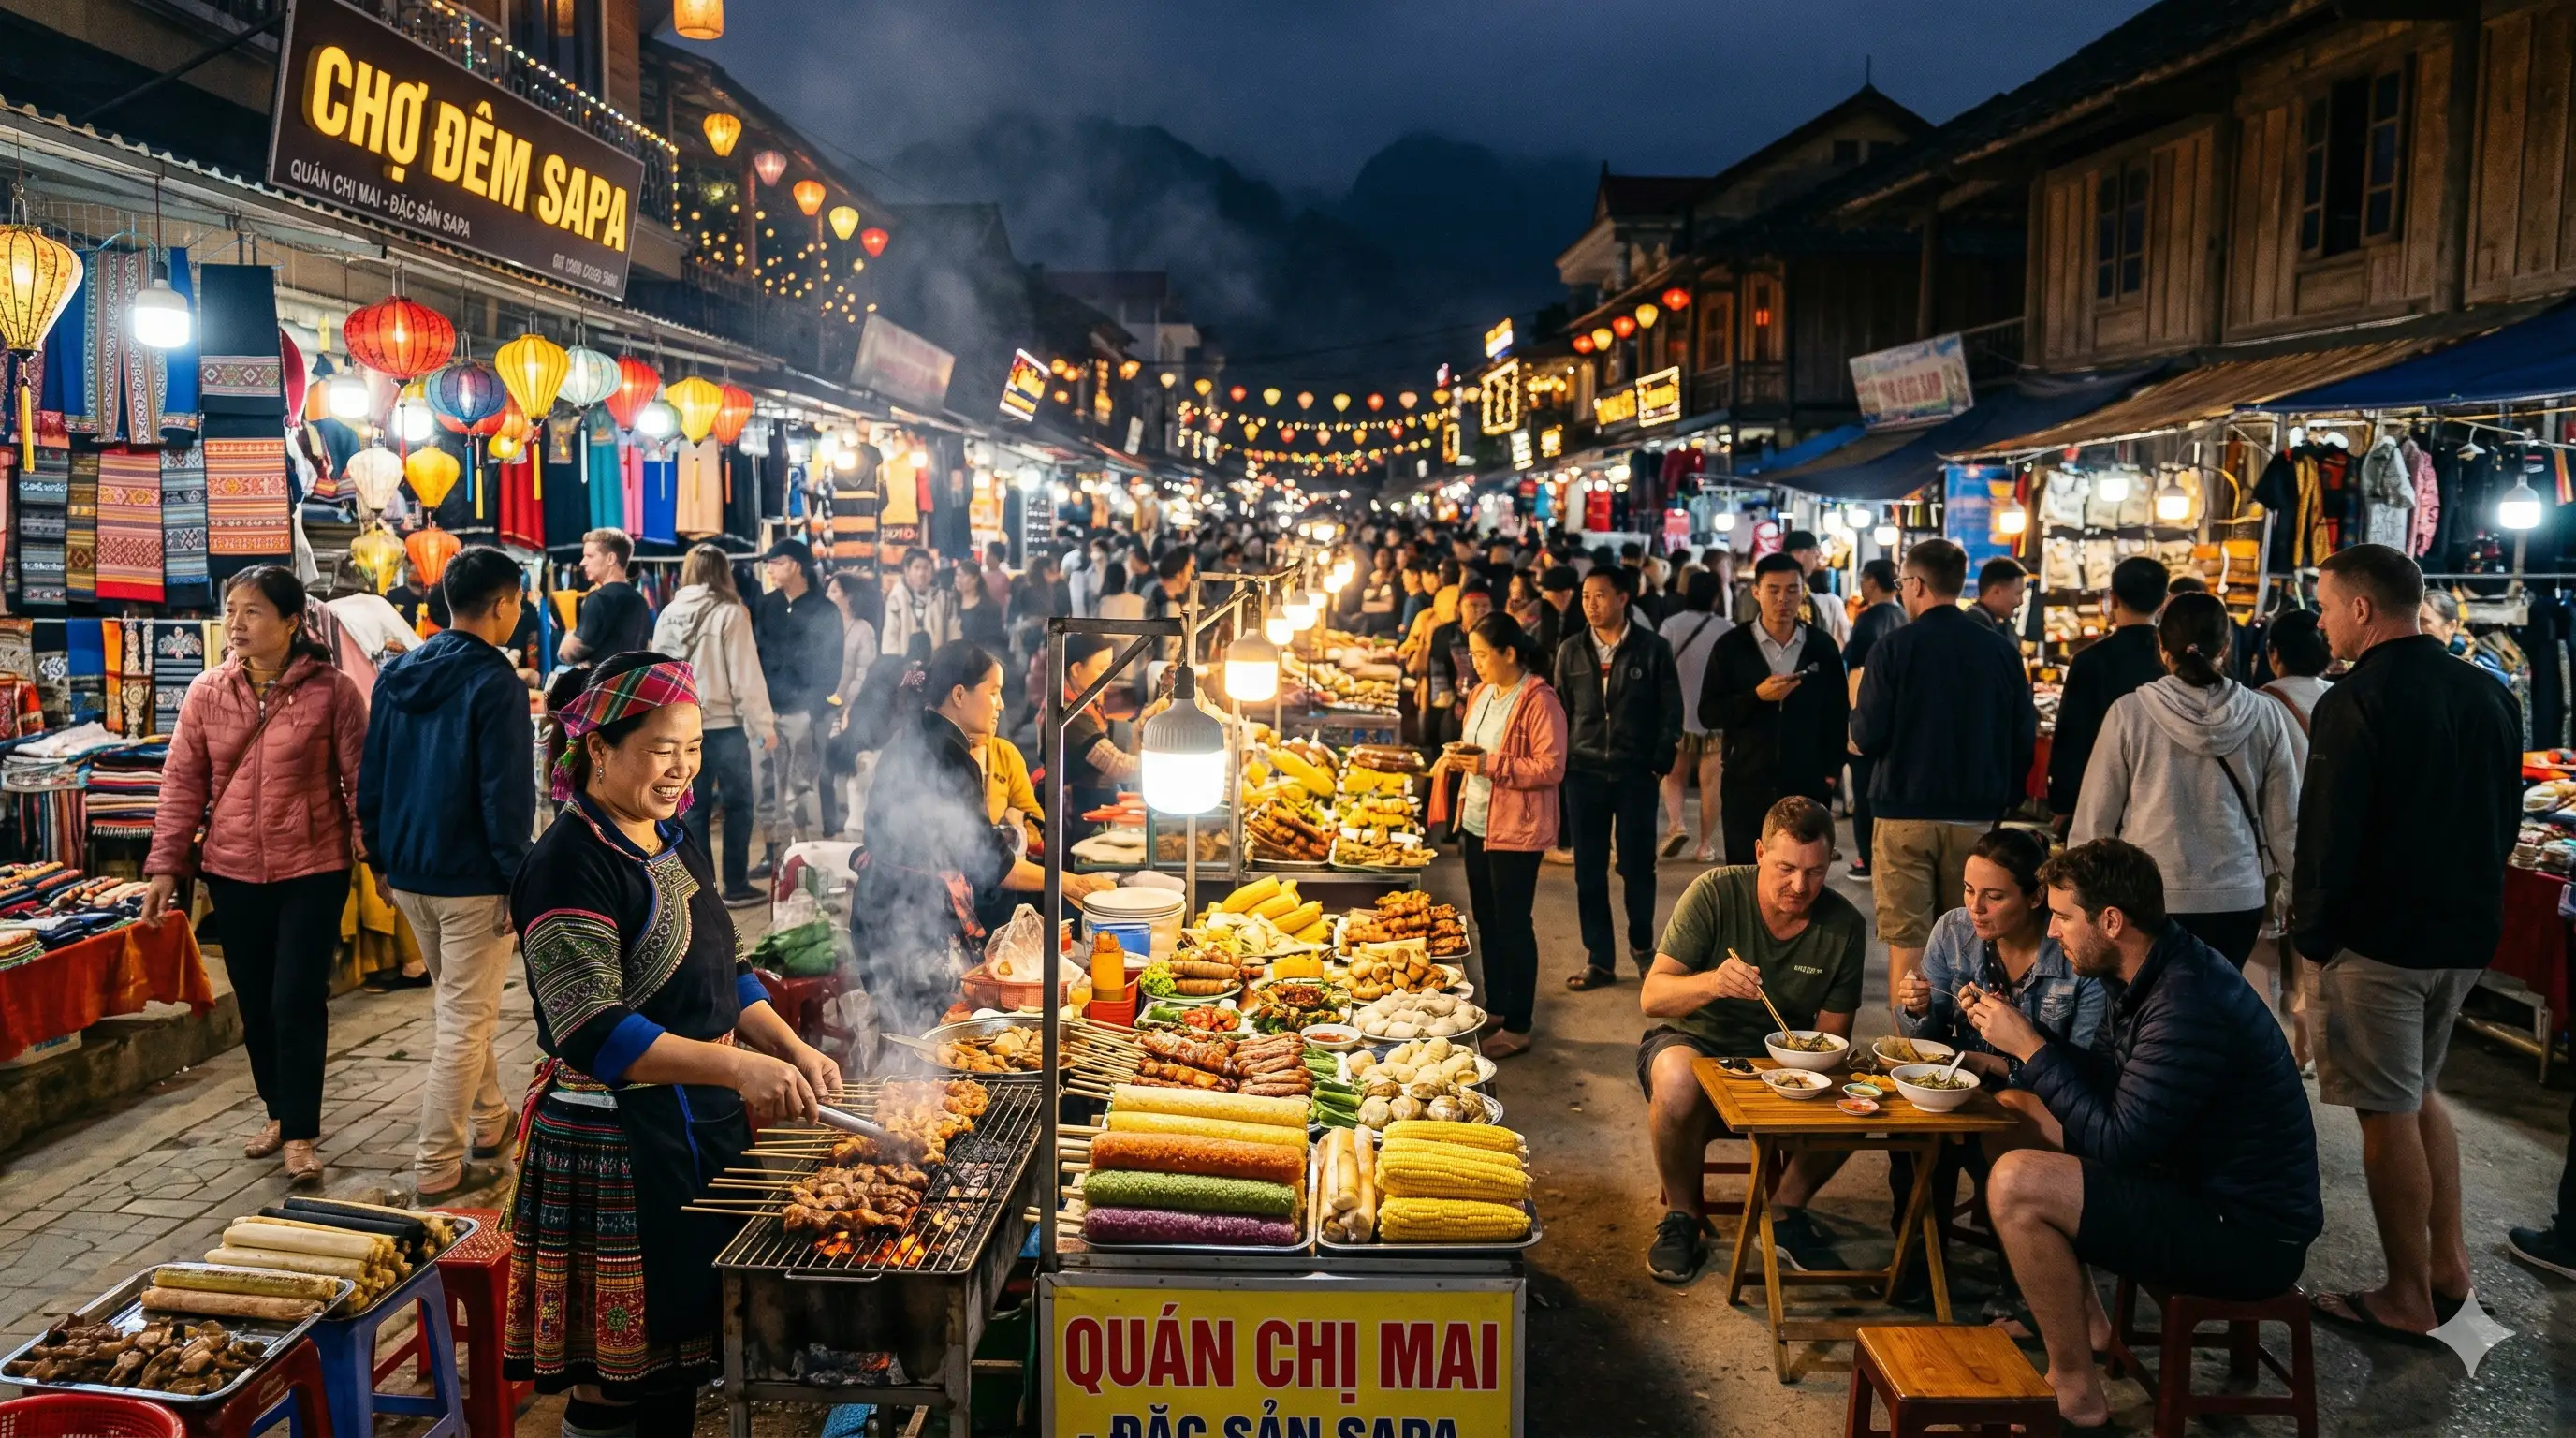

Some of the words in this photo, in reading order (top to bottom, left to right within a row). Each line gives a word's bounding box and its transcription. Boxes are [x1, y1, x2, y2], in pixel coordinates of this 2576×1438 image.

[290, 158, 330, 191] QUÁN
[333, 174, 357, 204] CHỊ
[359, 183, 382, 209] MAI
[389, 193, 416, 222] ĐẶC
[417, 199, 443, 229] SẢN
[443, 212, 471, 240] SAPA
[310, 45, 430, 183] CHỢ
[431, 99, 534, 213] ĐÊM
[537, 153, 628, 253] SAPA
[1064, 1302, 1235, 1395] QUÁN
[1255, 1319, 1358, 1406] CHỊ
[1379, 1320, 1500, 1391] MAI
